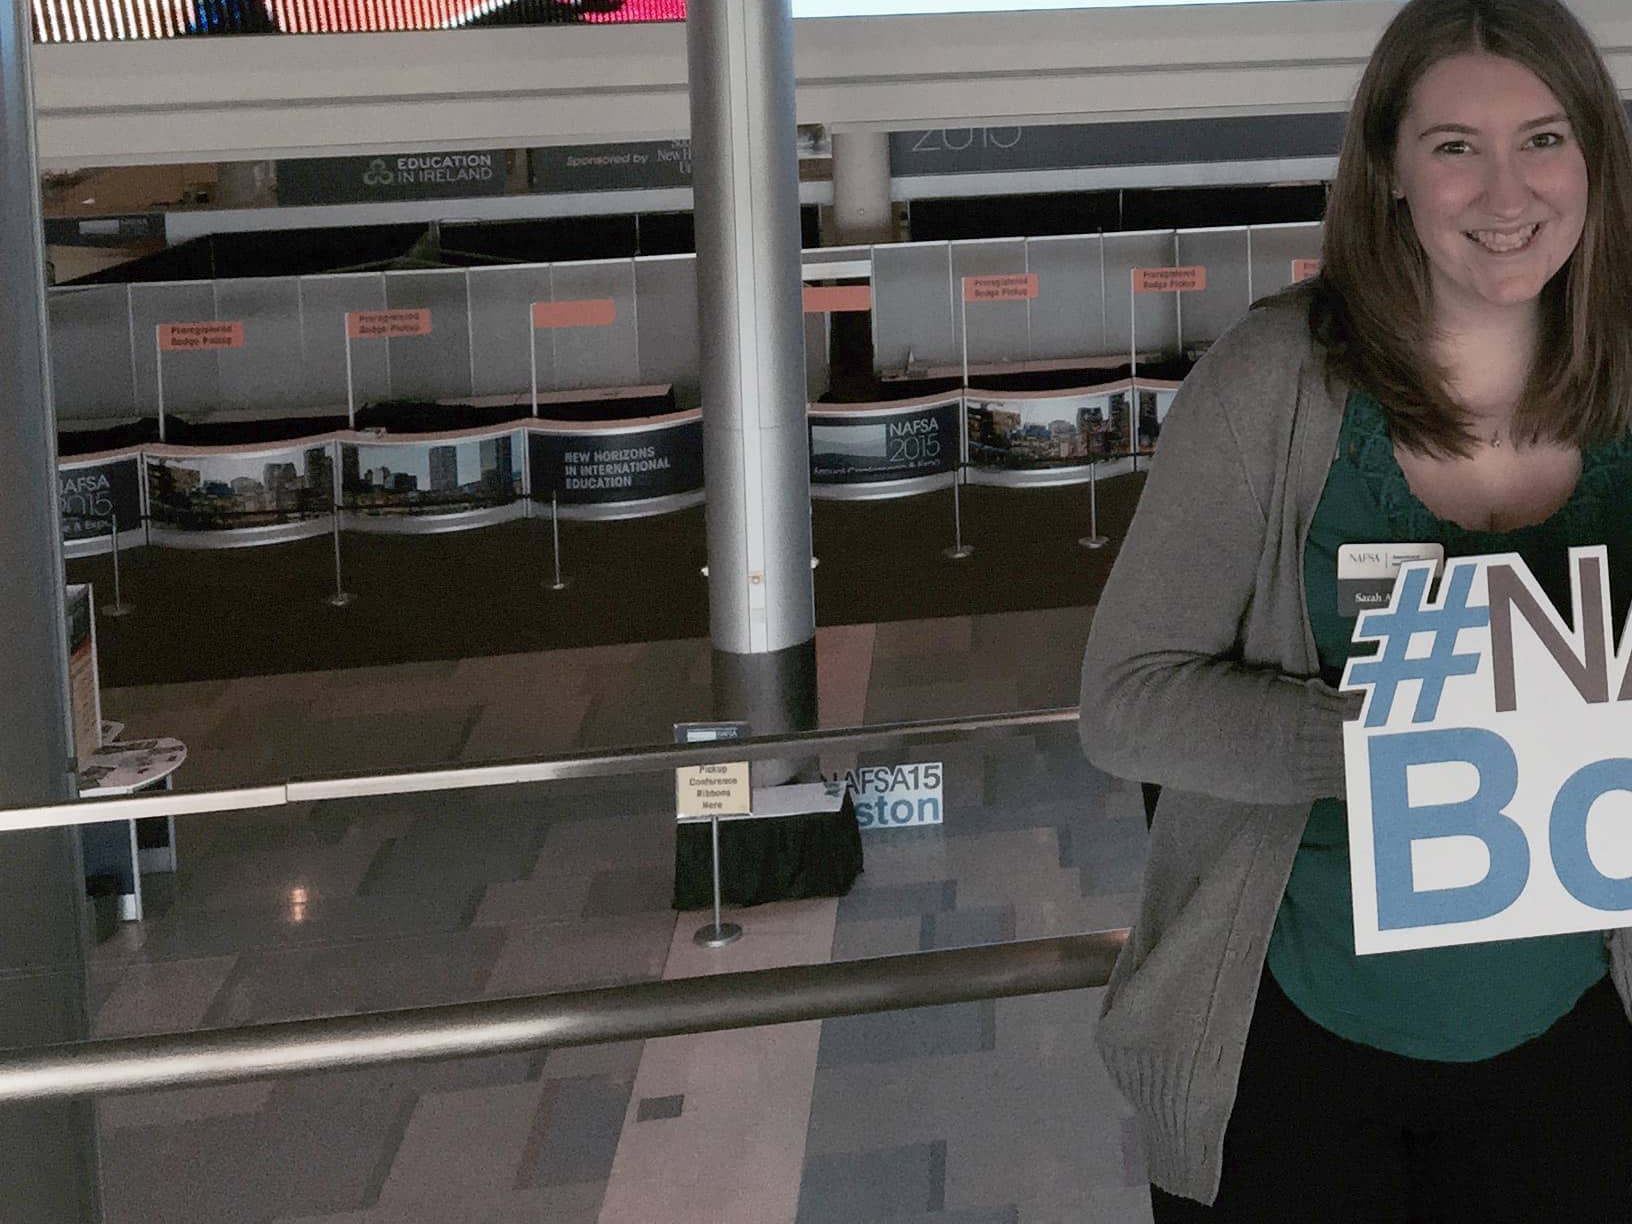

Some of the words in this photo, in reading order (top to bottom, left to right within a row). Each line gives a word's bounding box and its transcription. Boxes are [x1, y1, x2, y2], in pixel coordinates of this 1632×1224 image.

[397, 154, 492, 170] EDUCATION
[566, 153, 631, 167] Sponsored
[632, 153, 649, 165] by
[398, 170, 414, 184] IN
[419, 167, 493, 183] IRELAND
[889, 417, 940, 436] NAFSA
[564, 451, 591, 464] NEW
[594, 445, 656, 463] HORIZONS
[890, 433, 942, 463] 2015
[564, 464, 578, 477] IN
[580, 456, 672, 476] INTERNATIONAL
[565, 475, 633, 489] EDUCATION
[1354, 591, 1383, 603] Sarah
[689, 777, 738, 787] Conference
[702, 800, 723, 810] Here
[855, 794, 941, 827] ston
